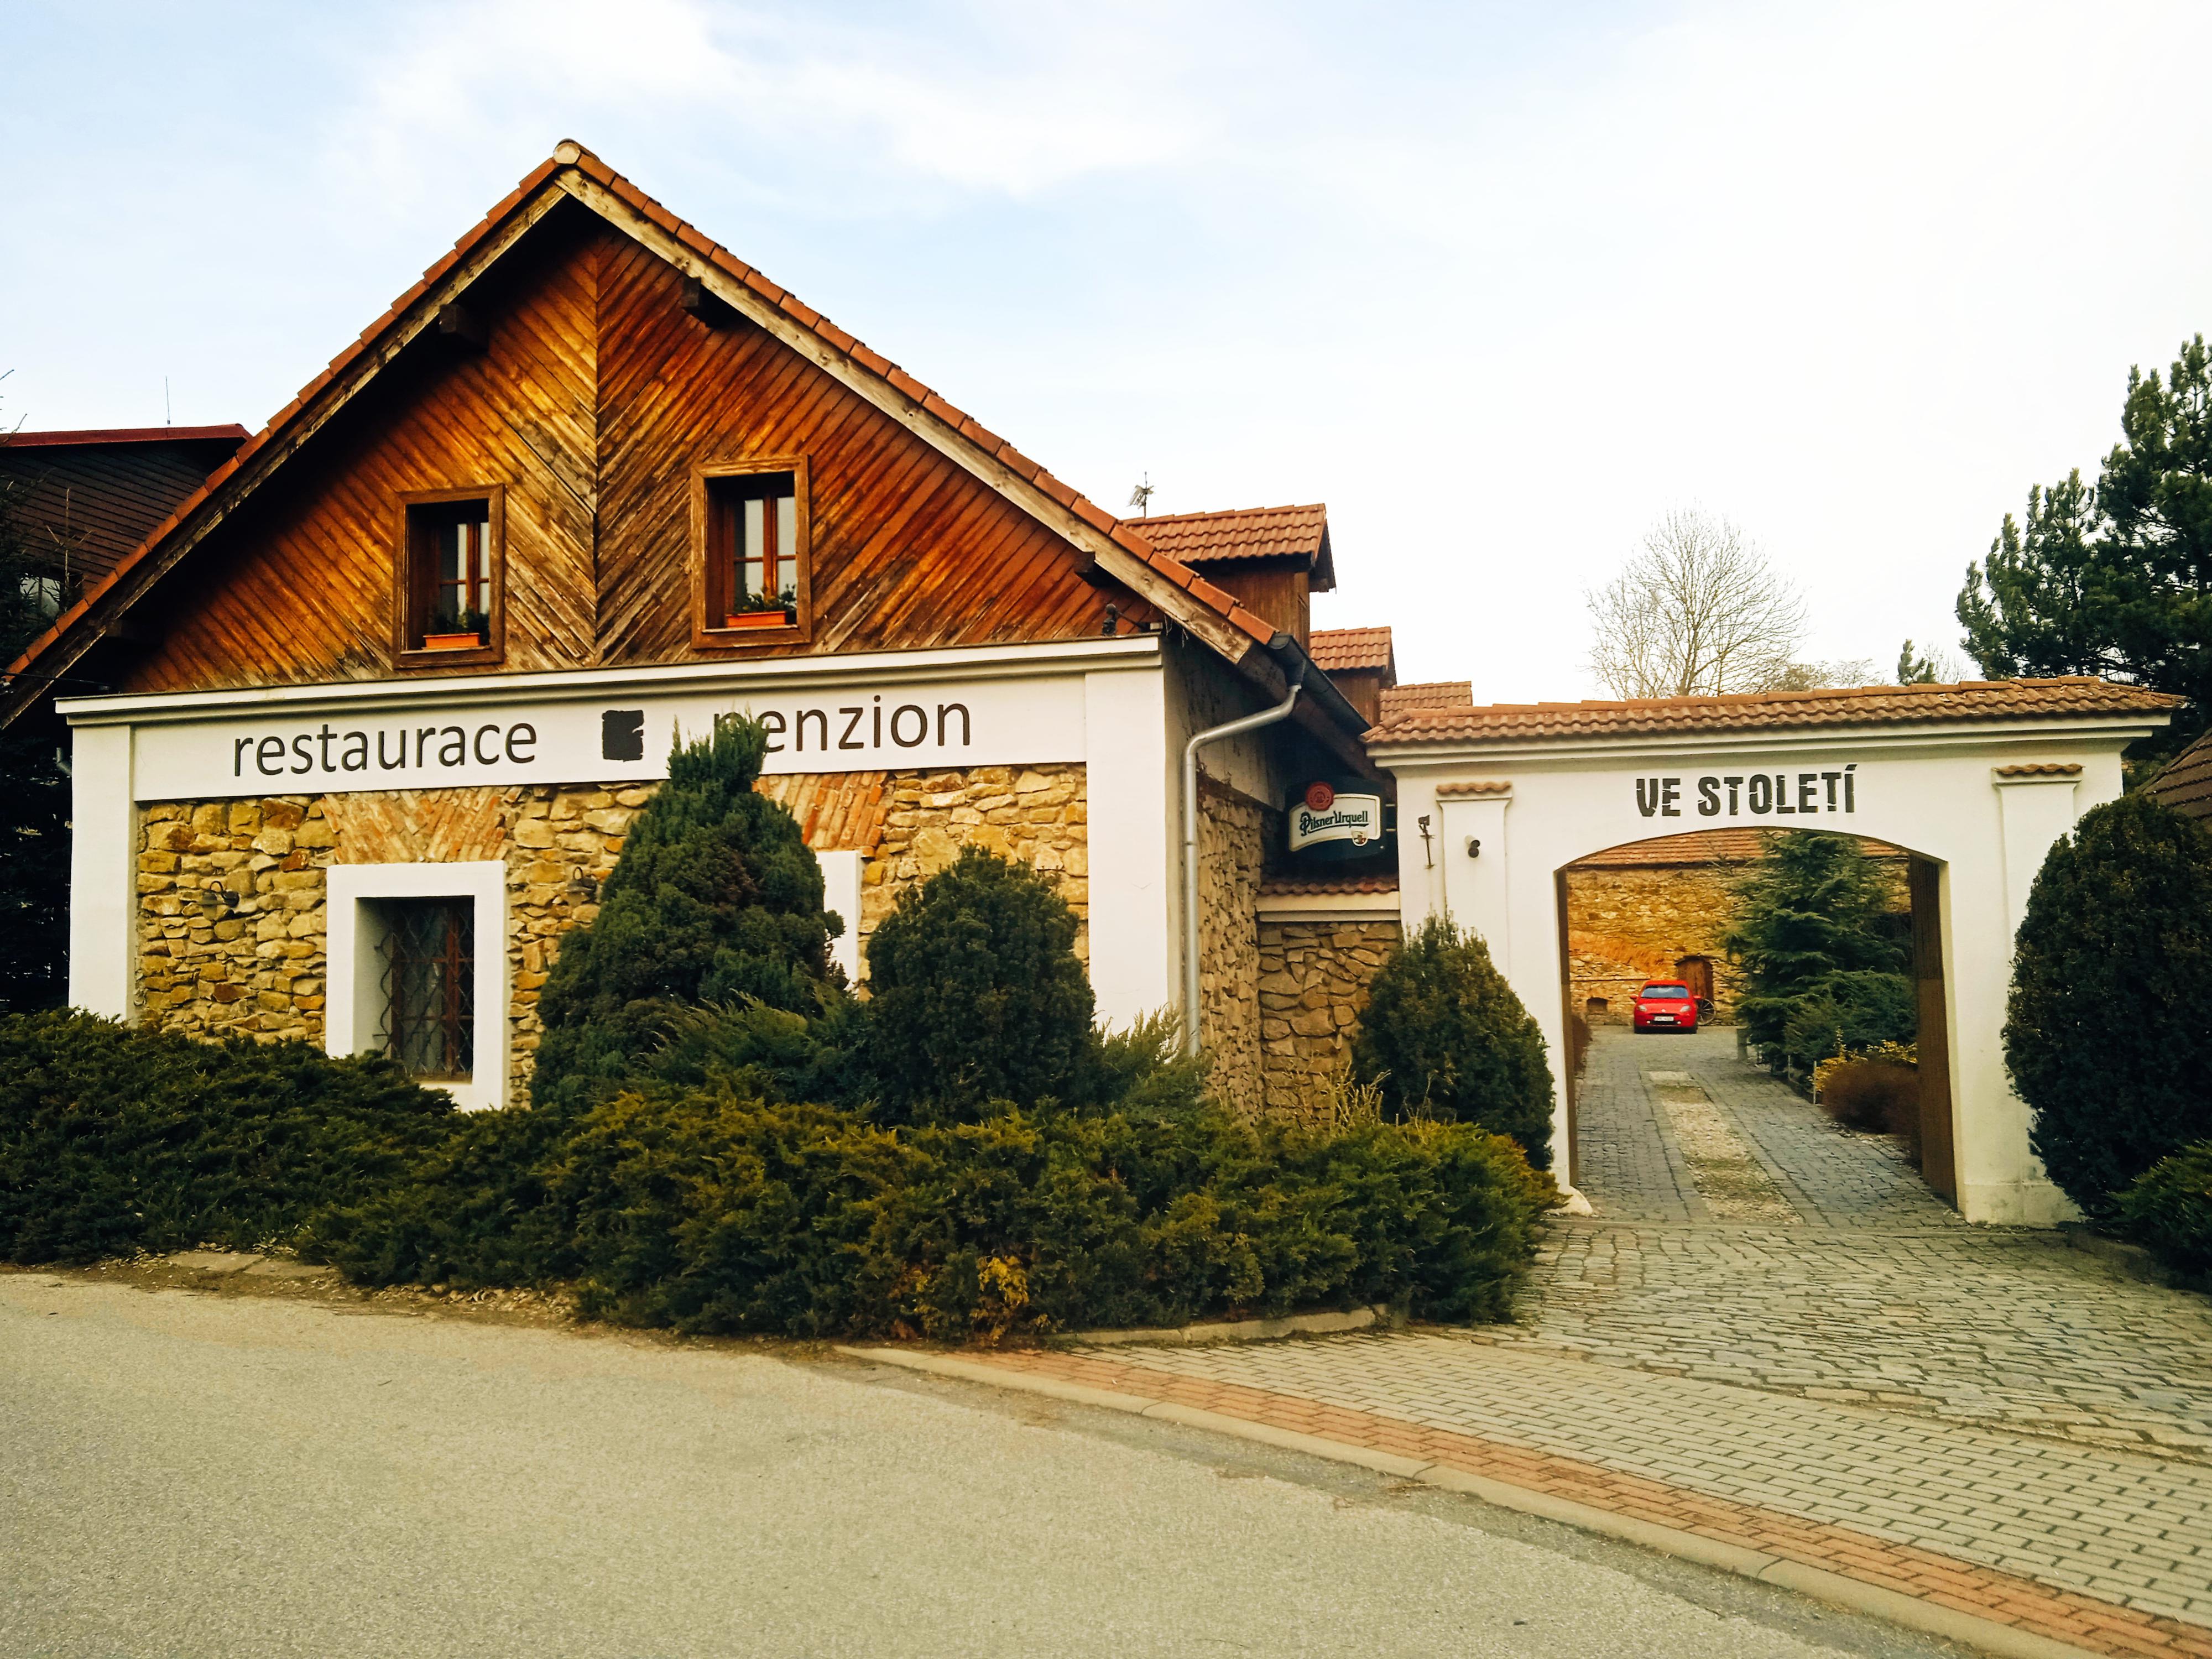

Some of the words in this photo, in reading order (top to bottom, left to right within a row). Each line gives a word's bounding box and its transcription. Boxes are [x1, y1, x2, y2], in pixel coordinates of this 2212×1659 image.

[234, 722, 537, 777] restaurace
[1636, 778, 1681, 817] VE
[1697, 764, 1858, 817] STOLETÍ
[1300, 811, 1334, 837] Pilsner
[1333, 810, 1368, 828] Urquell
